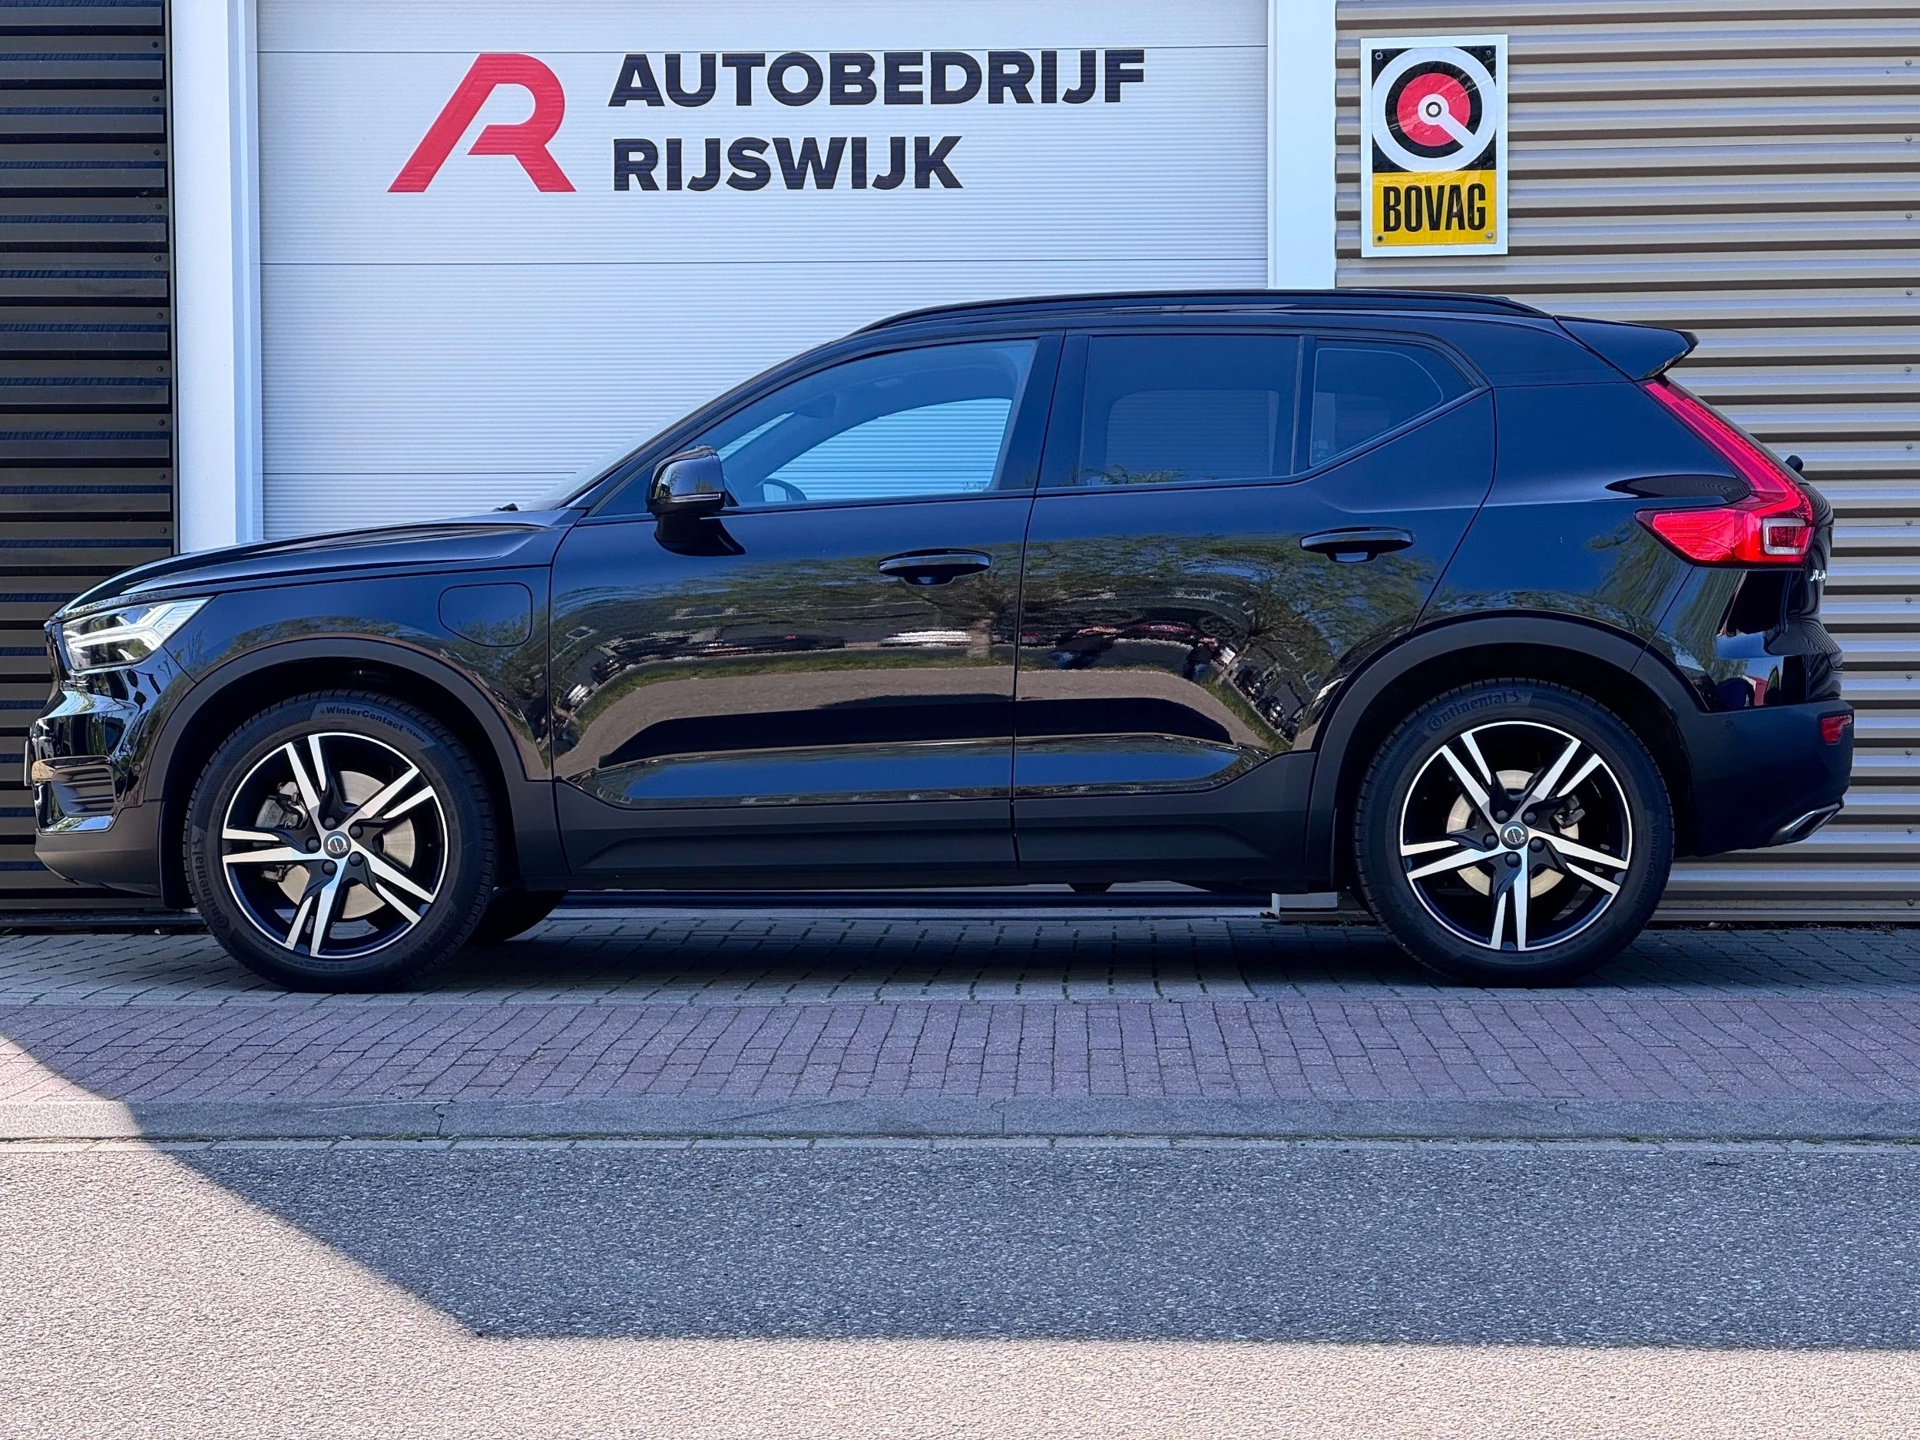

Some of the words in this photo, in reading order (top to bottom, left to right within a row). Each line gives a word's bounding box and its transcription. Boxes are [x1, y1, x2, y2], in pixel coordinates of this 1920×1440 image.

[608, 48, 1145, 108] AUTOBEDRIJF
[613, 134, 964, 192] RIJSWIJK
[1382, 183, 1487, 233] BOVAG
[325, 705, 404, 732] WinterContact
[1427, 691, 1508, 732] Continental
[192, 850, 230, 930] Continental
